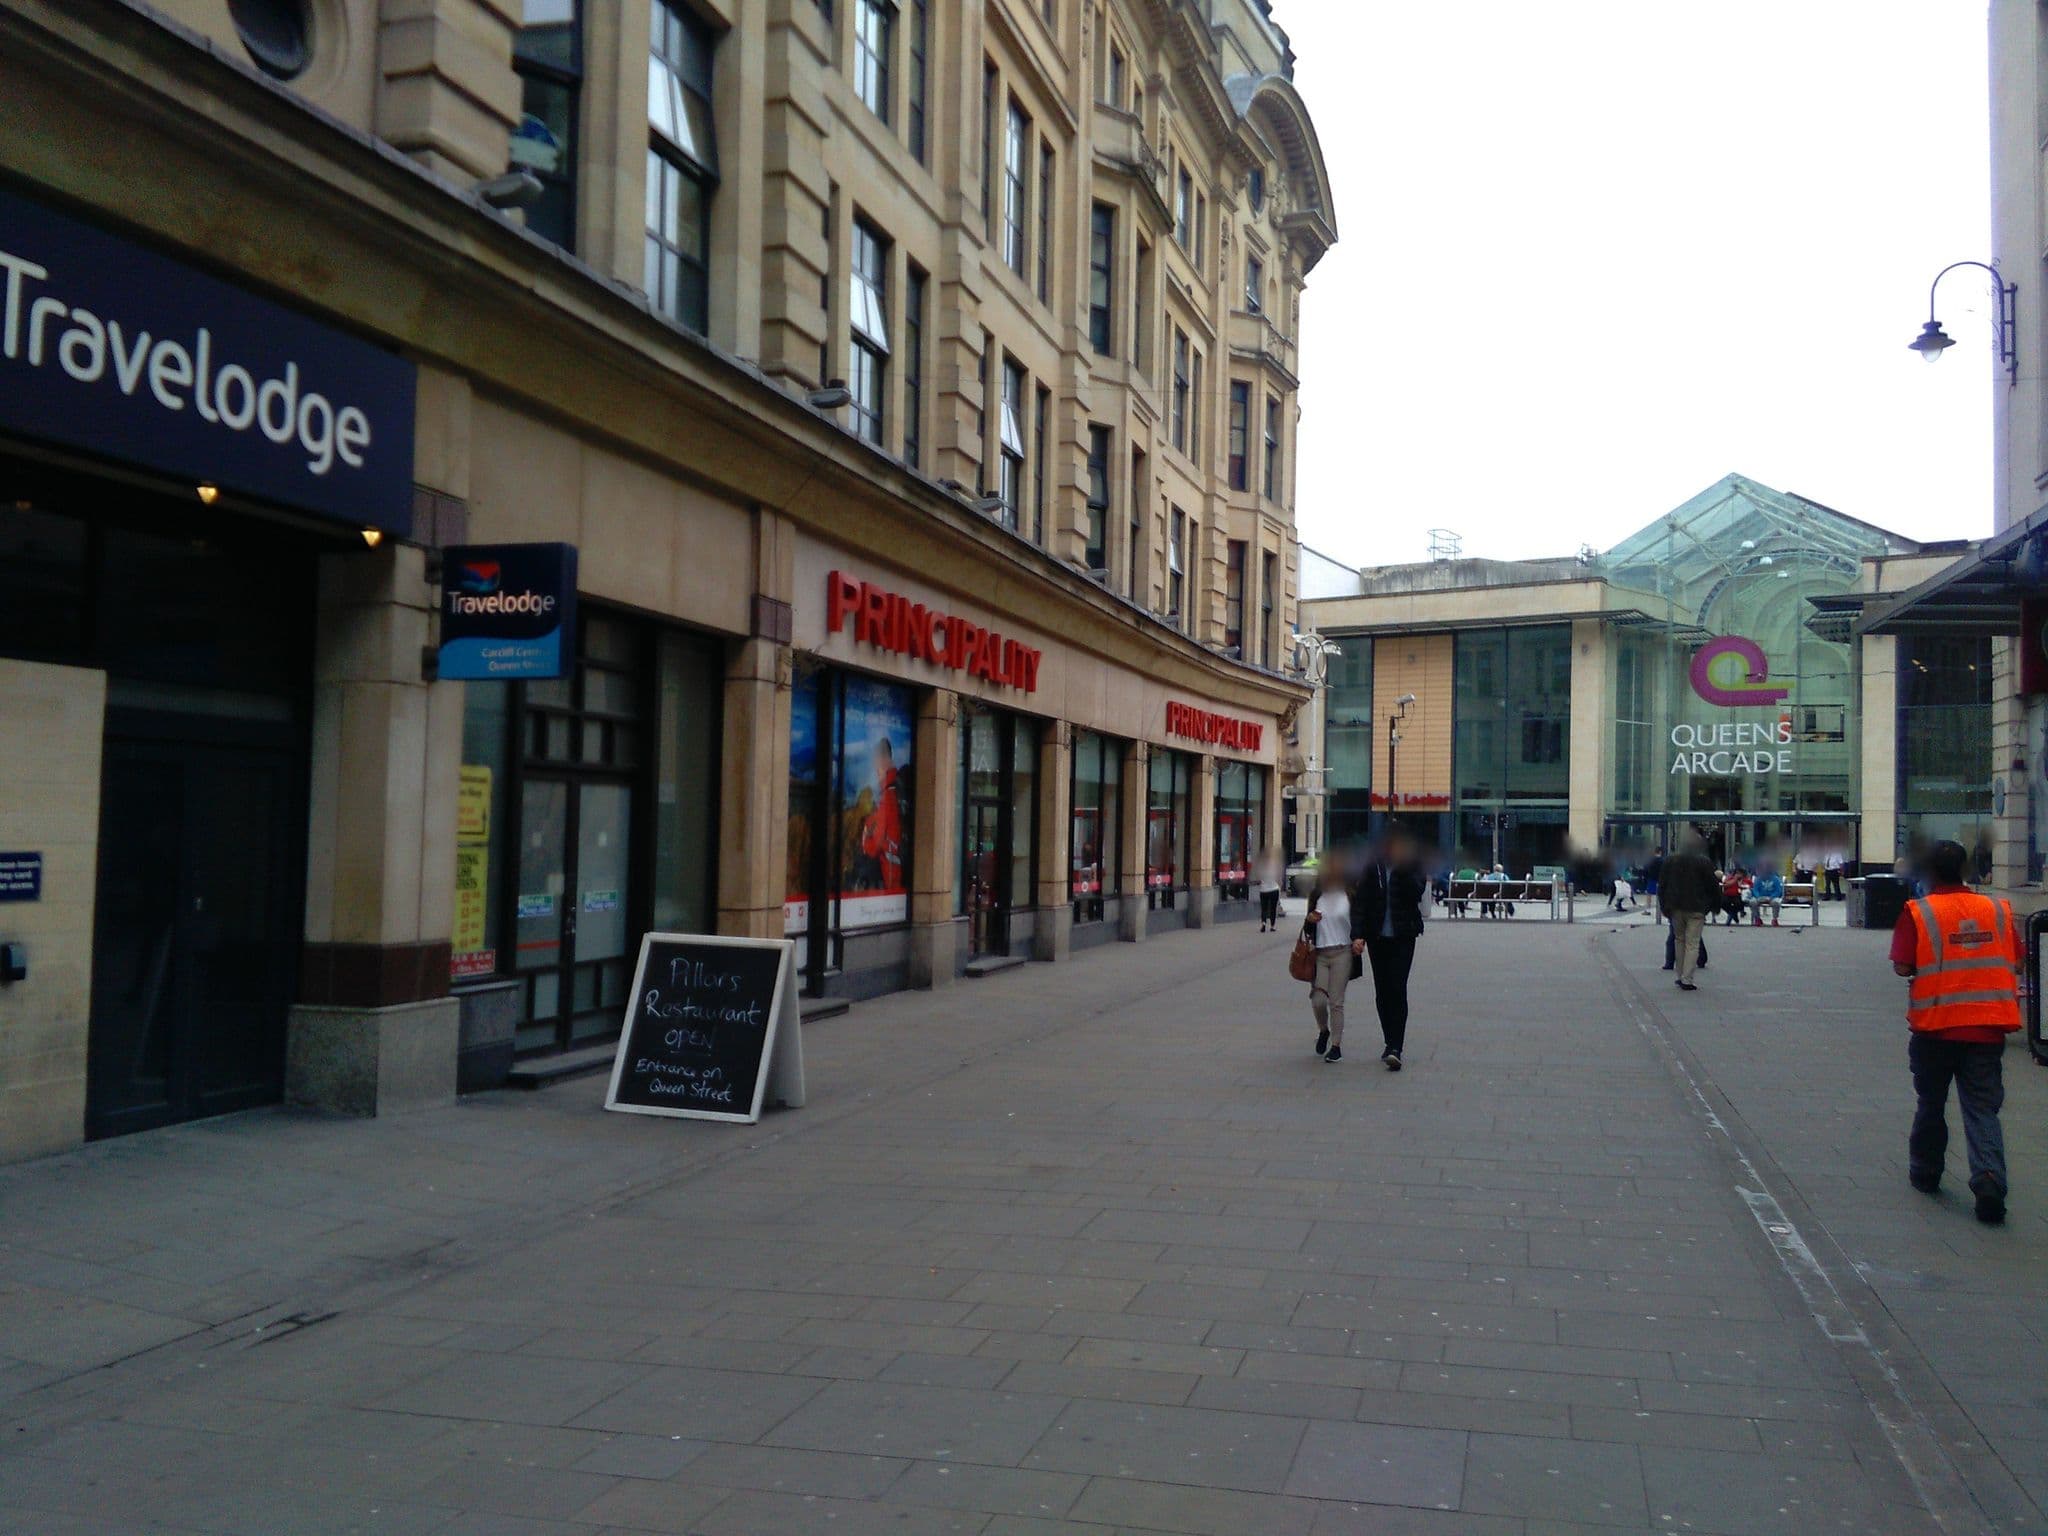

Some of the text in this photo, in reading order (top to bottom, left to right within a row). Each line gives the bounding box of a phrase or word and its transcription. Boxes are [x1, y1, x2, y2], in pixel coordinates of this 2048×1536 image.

[0, 253, 372, 476] Travelodge
[447, 590, 556, 616] Travelodge
[827, 569, 1042, 693] PRINCIPALITY
[1165, 700, 1264, 752] PRINCIPALITY
[1671, 722, 1792, 748] QUEENS
[1671, 750, 1793, 774] ARCADE
[670, 956, 742, 992] Pillars
[645, 989, 761, 1025] Restaurant
[664, 1029, 713, 1049] OPEN
[702, 1066, 722, 1079] on
[649, 1077, 733, 1102] Queen Street
